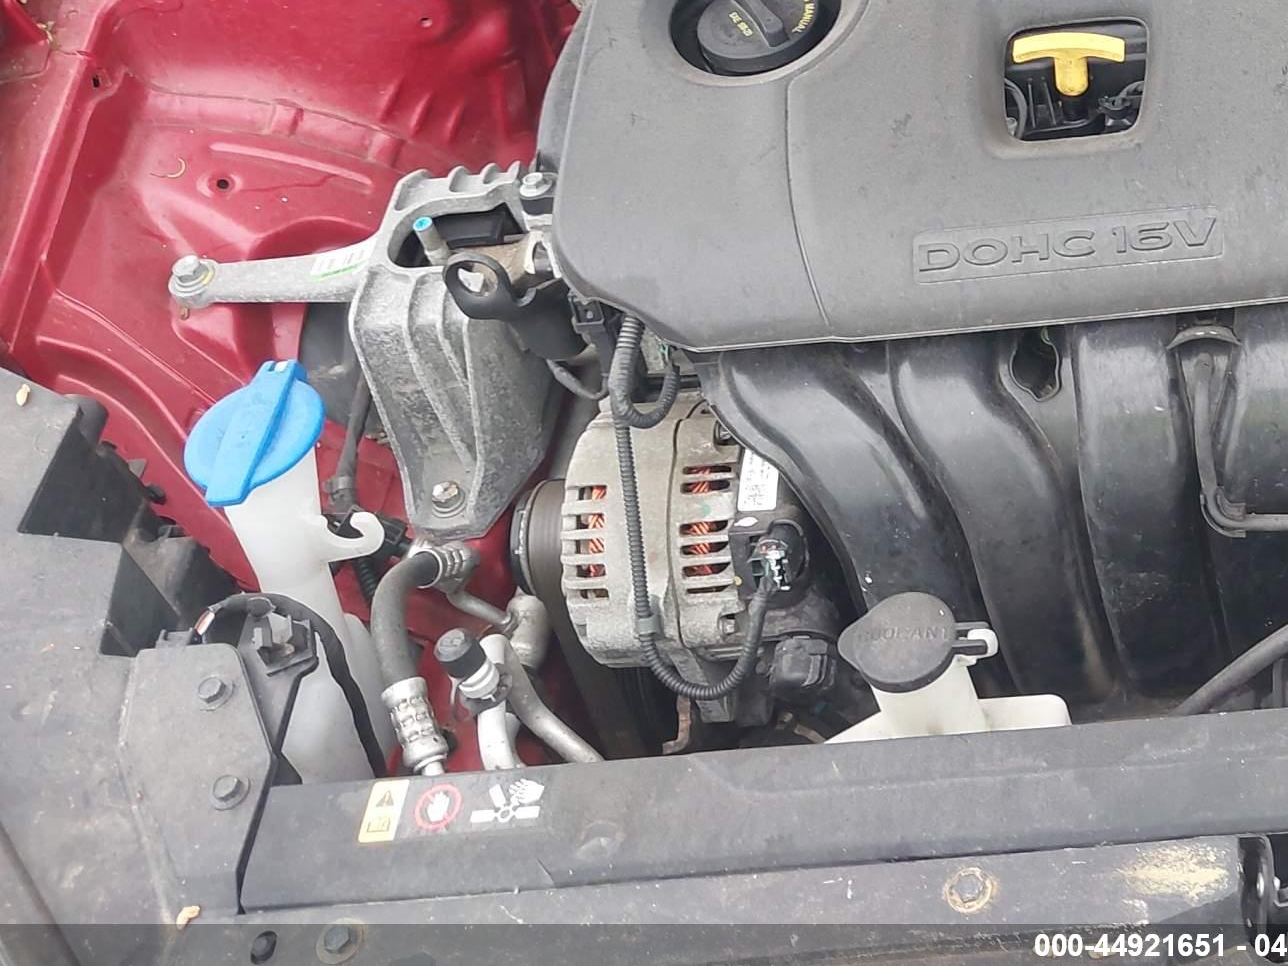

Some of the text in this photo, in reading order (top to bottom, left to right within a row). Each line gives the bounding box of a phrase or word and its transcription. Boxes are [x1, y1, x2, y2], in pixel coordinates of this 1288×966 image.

[791, 2, 816, 33] MANUAL
[918, 217, 1217, 273] DOHC 16V
